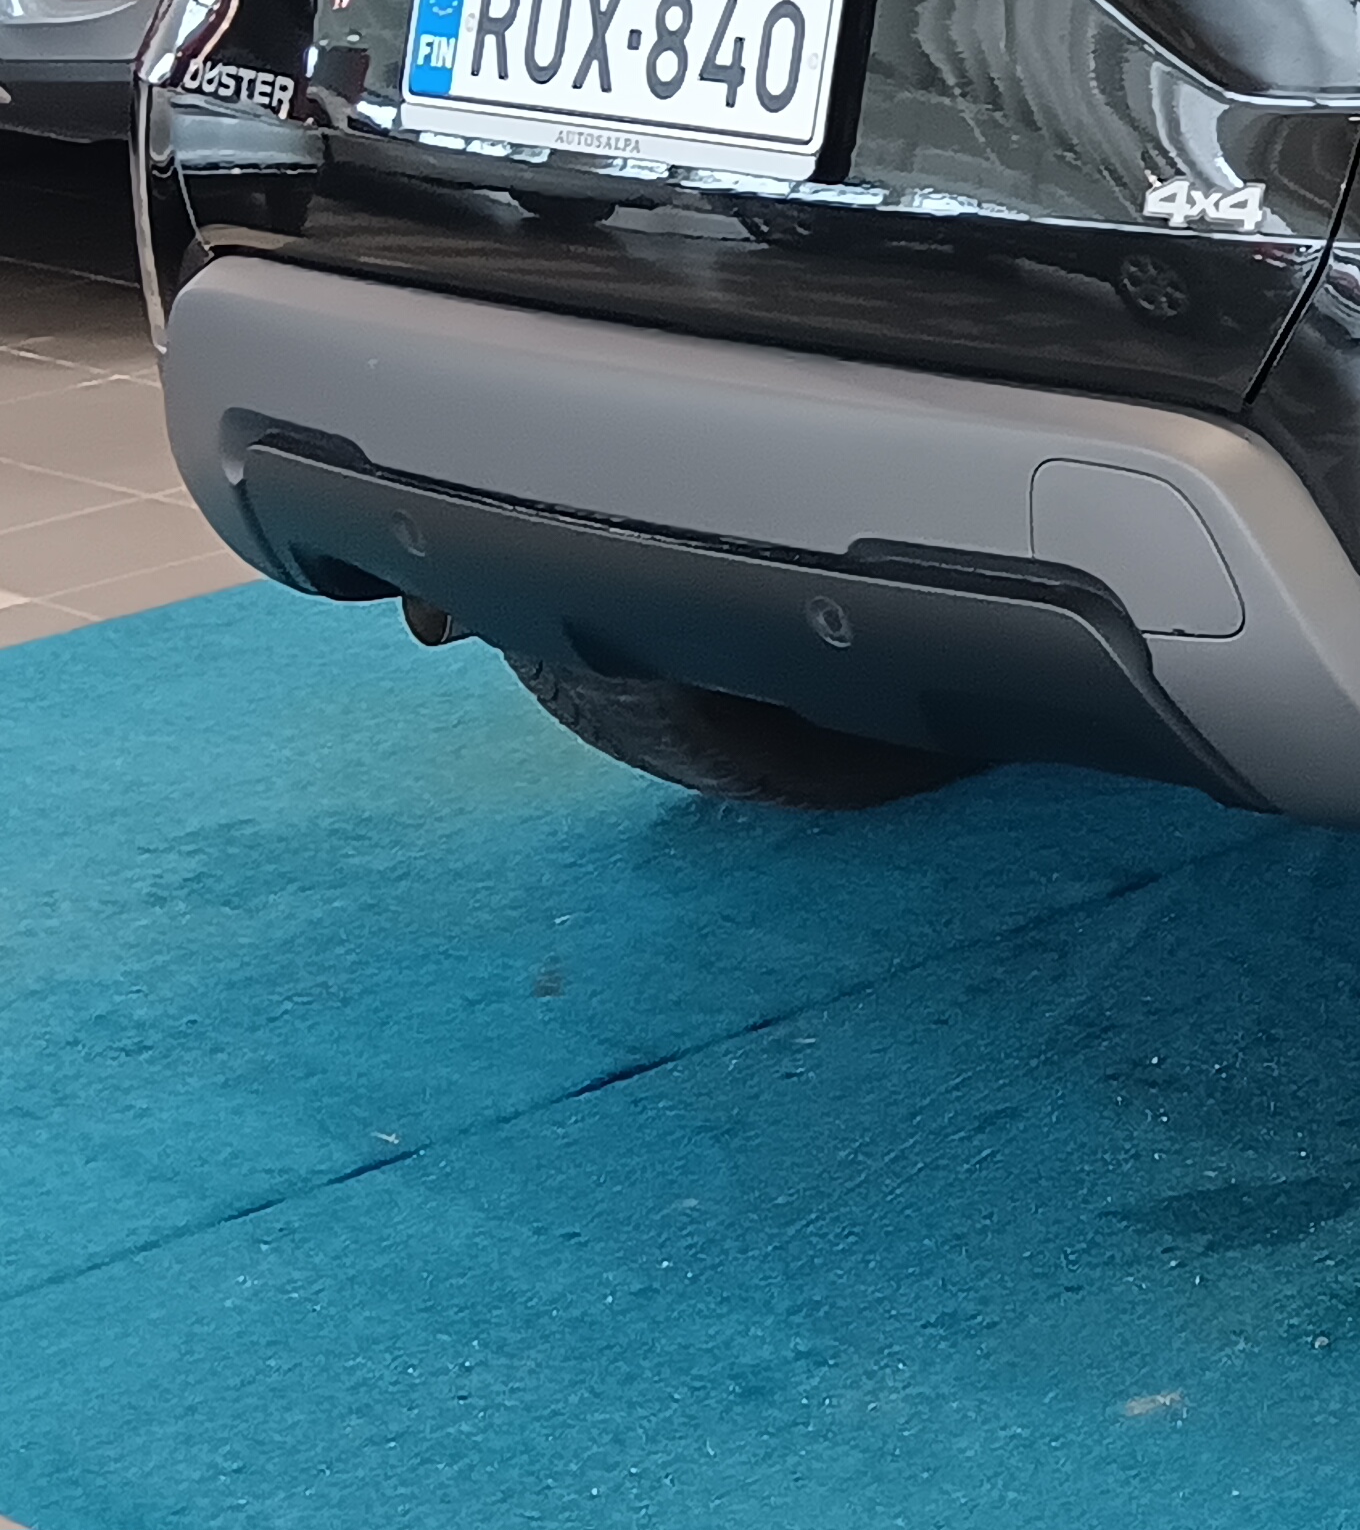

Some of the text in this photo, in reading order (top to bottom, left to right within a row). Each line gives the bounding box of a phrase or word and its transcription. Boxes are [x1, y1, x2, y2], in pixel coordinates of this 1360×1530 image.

[416, 34, 456, 70] FIN
[182, 58, 295, 120] DUSTER
[554, 130, 642, 154] AUTOSALPA
[1142, 176, 1266, 232] 4x4
